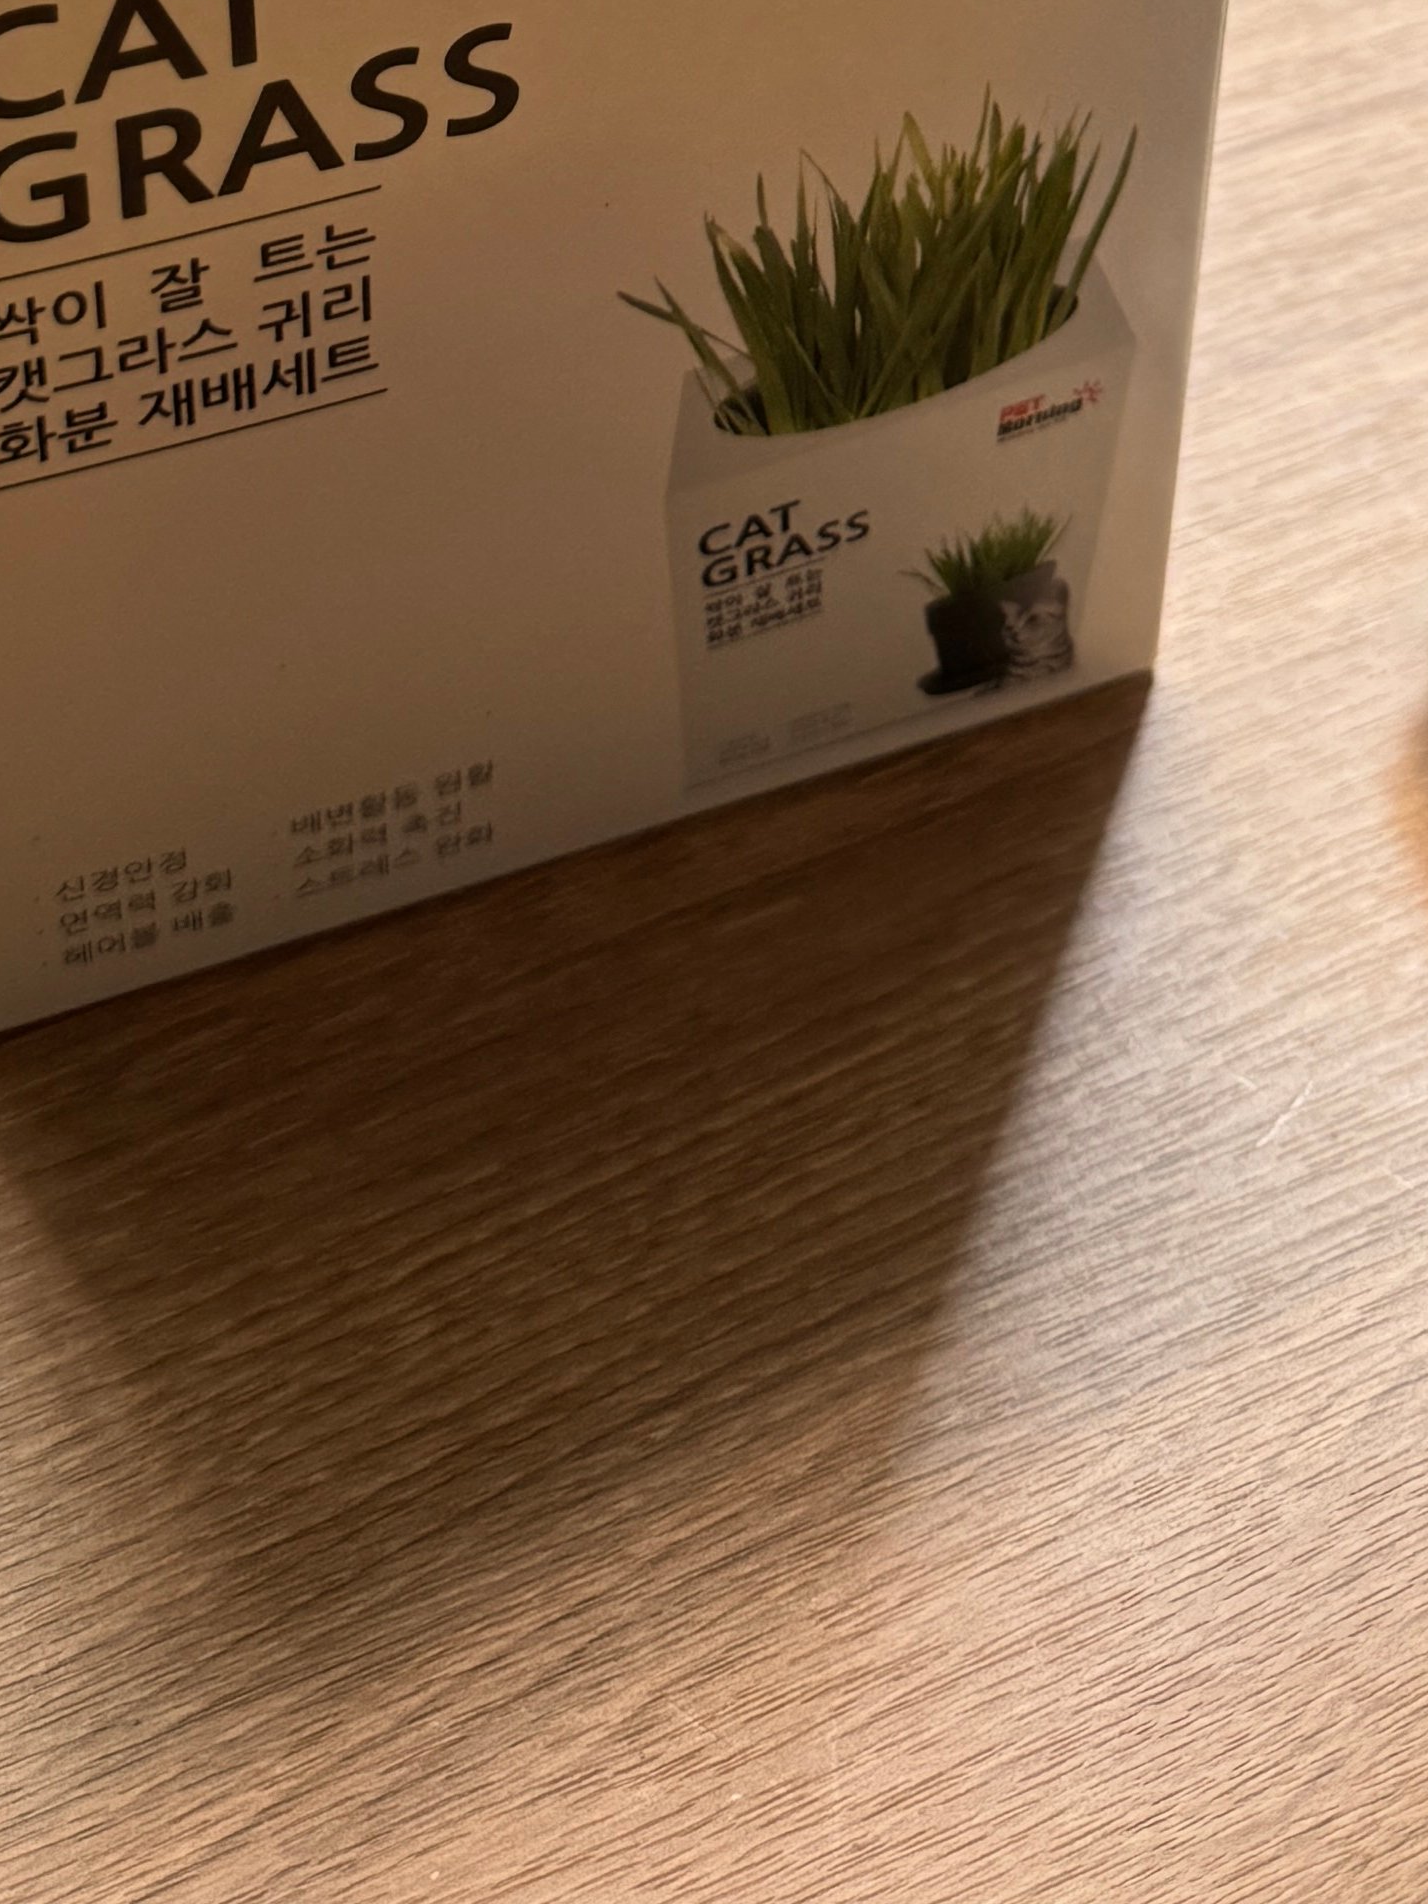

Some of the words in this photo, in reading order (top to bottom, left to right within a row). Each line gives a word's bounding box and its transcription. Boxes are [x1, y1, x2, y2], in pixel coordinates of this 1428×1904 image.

[150, 257, 210, 314] 잘
[253, 224, 377, 283] 트는
[258, 275, 373, 344] 귀리
[138, 334, 380, 428] 재배세트
[698, 500, 801, 556] CAT
[701, 510, 870, 589] GRASS
